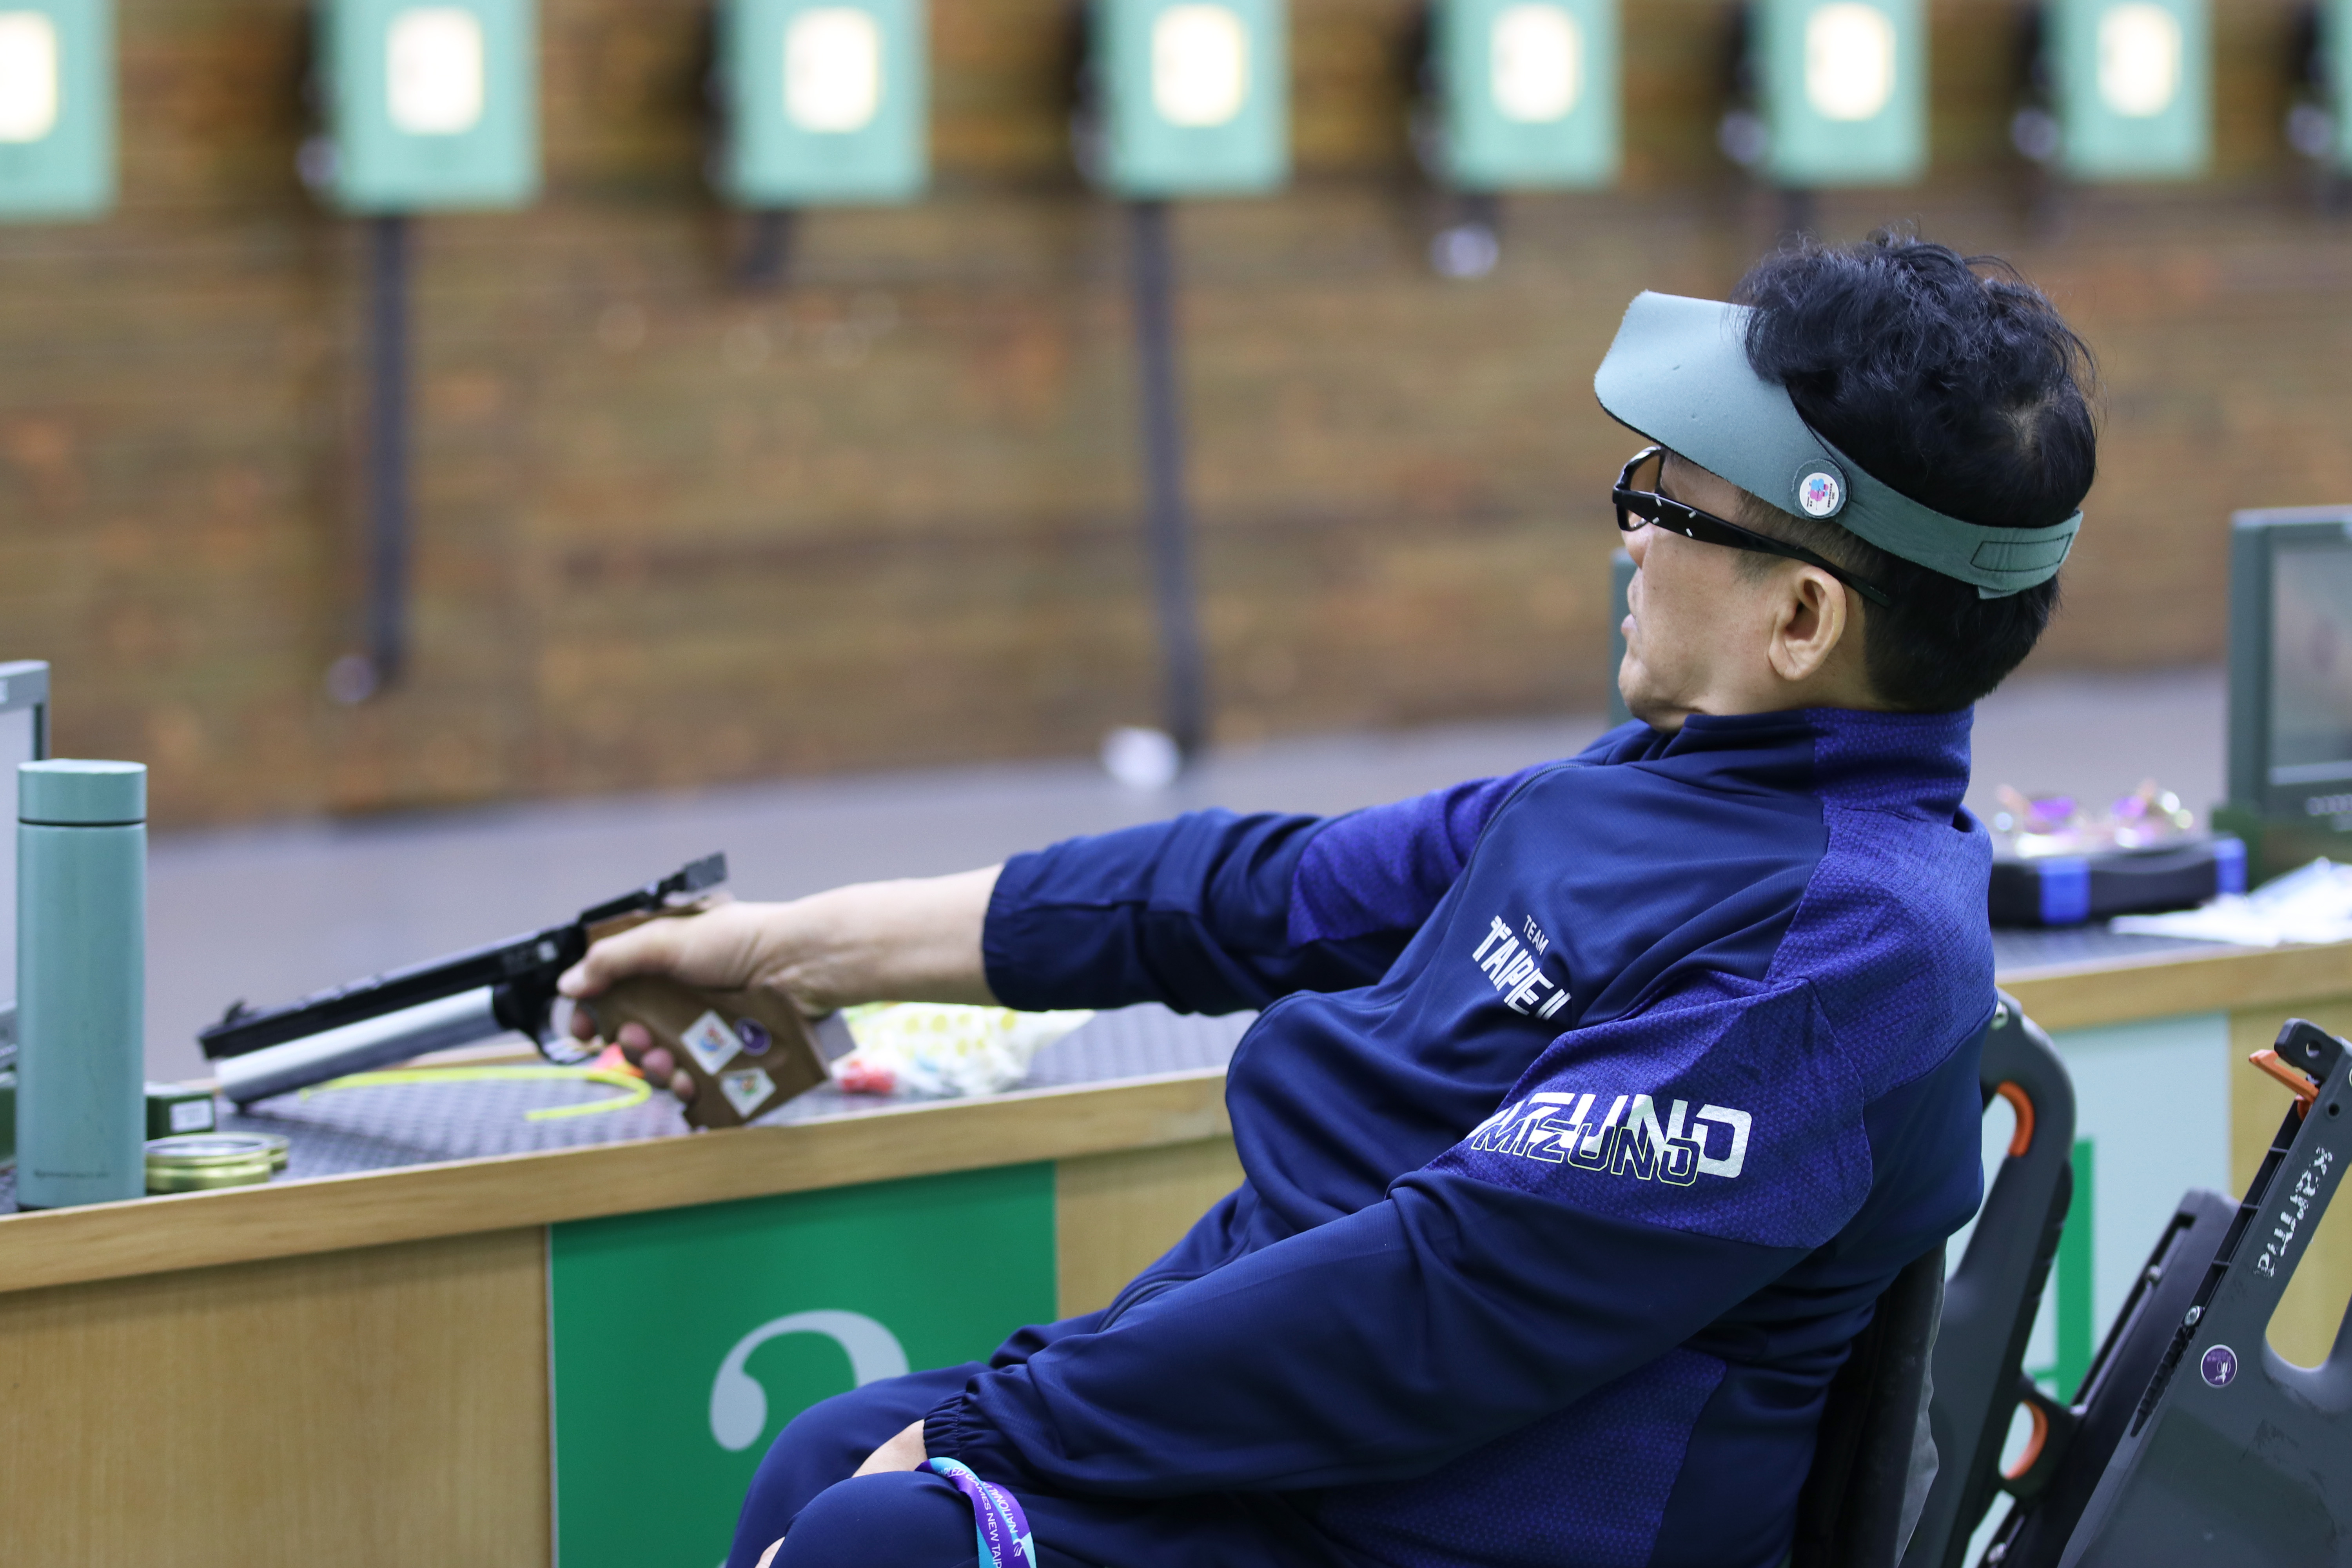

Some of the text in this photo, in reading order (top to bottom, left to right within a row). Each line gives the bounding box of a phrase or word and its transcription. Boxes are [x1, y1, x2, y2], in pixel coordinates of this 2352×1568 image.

[1523, 914, 1549, 956] TEAM
[1471, 1118, 1700, 1187] MIZUNO
[965, 1474, 992, 1510] GAMES
[986, 1512, 1000, 1542] NEW
[989, 1488, 1018, 1534] NATIONAL
